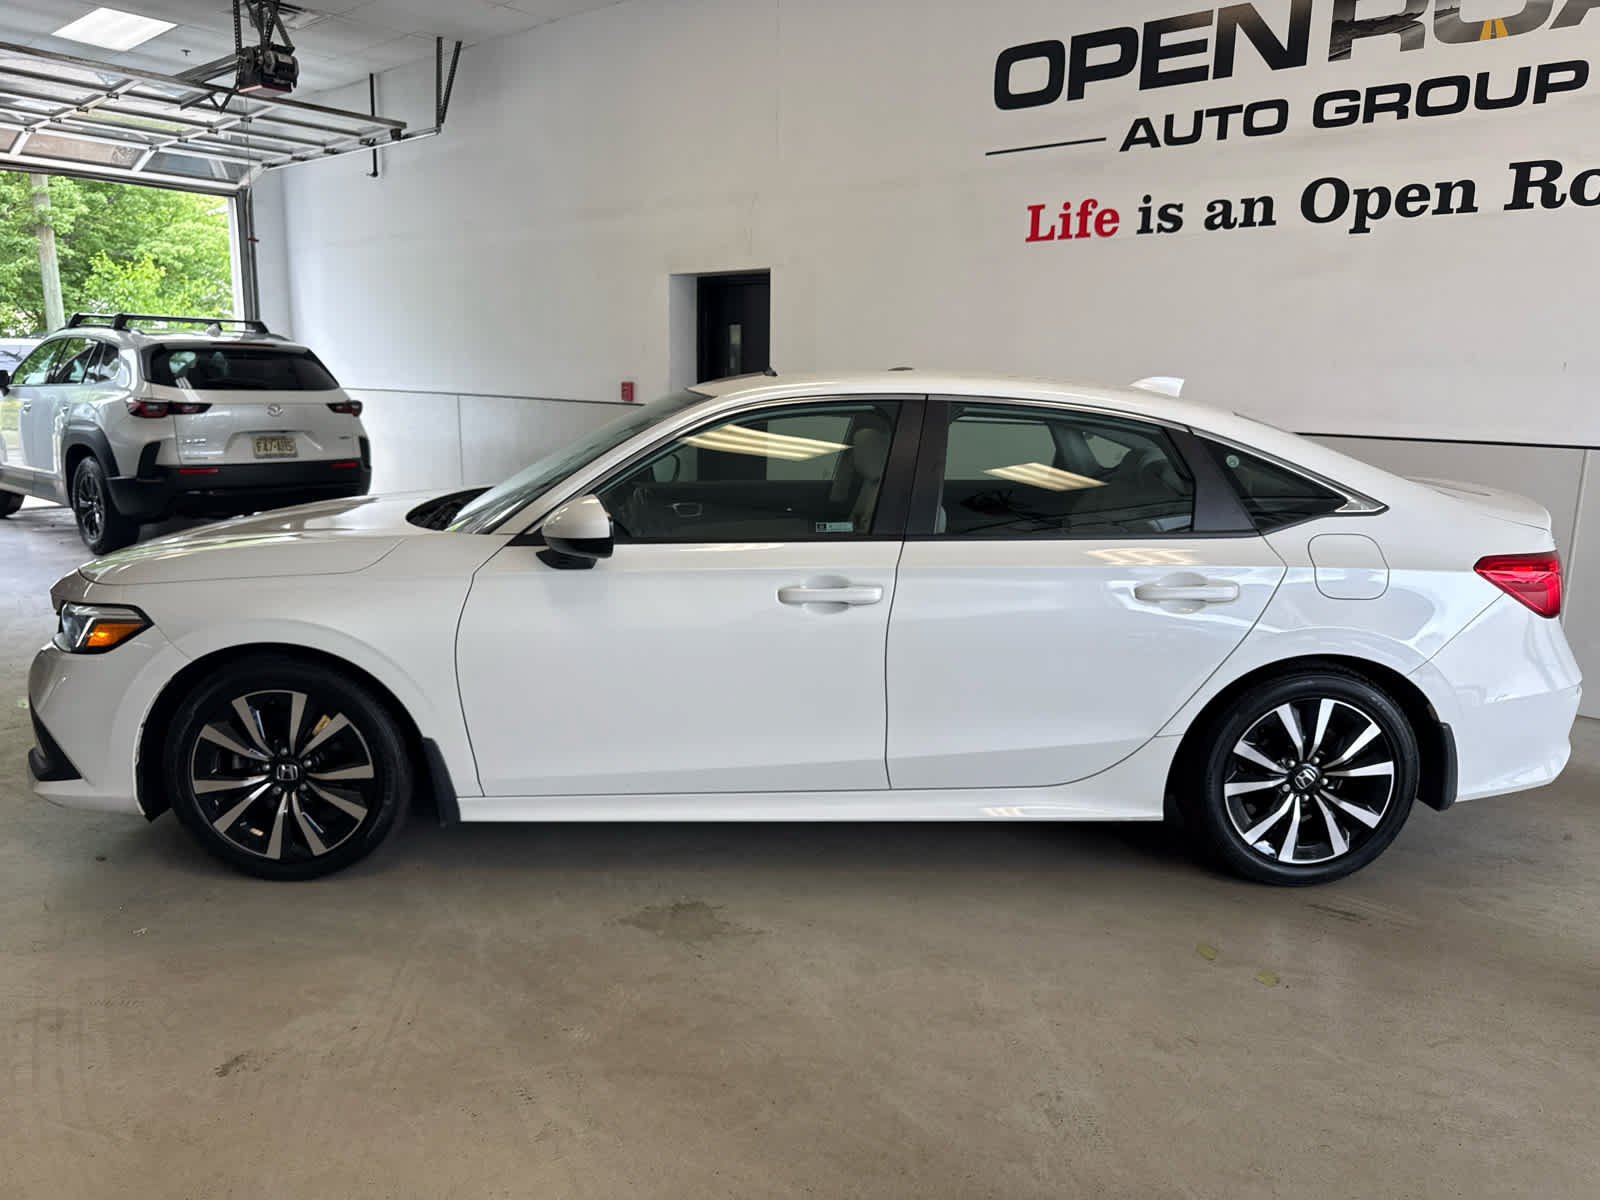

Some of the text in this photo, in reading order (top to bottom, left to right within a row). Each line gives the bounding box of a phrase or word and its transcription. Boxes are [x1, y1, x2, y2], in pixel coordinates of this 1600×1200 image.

[994, 0, 1600, 110] OPEN RO
[1119, 60, 1589, 152] AUTO GROUP
[1025, 198, 1119, 242] Life
[1136, 195, 1183, 234] is
[1204, 196, 1276, 230] an
[1301, 177, 1478, 234] Open
